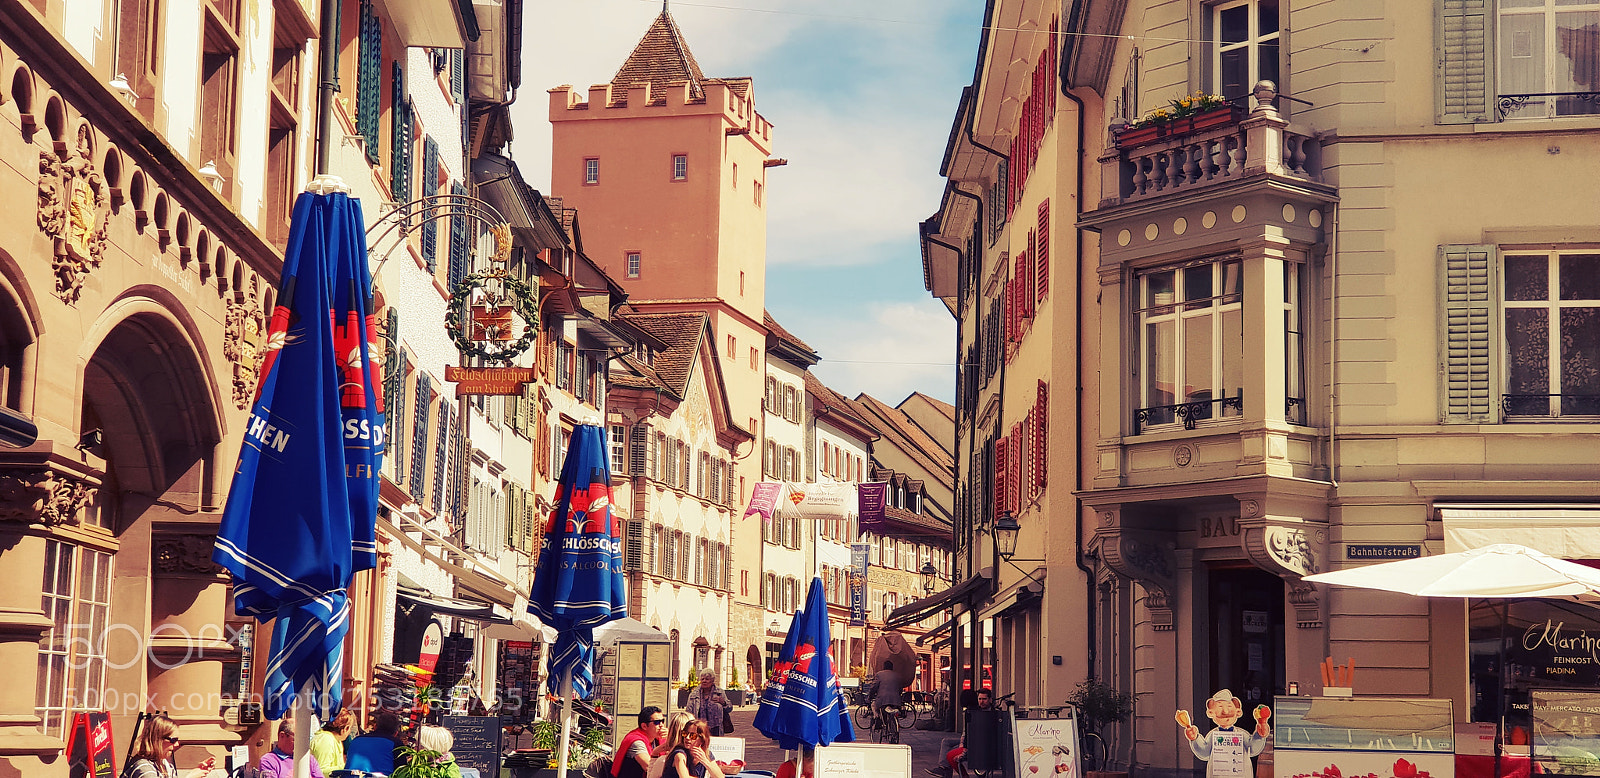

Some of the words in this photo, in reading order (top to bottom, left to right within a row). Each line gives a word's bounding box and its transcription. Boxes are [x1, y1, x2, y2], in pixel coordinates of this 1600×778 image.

[465, 385, 482, 393] am
[1350, 546, 1418, 556] Bahnhofstraße
[1553, 656, 1592, 664] FEINKOST
[1546, 667, 1577, 675] PIADINA
